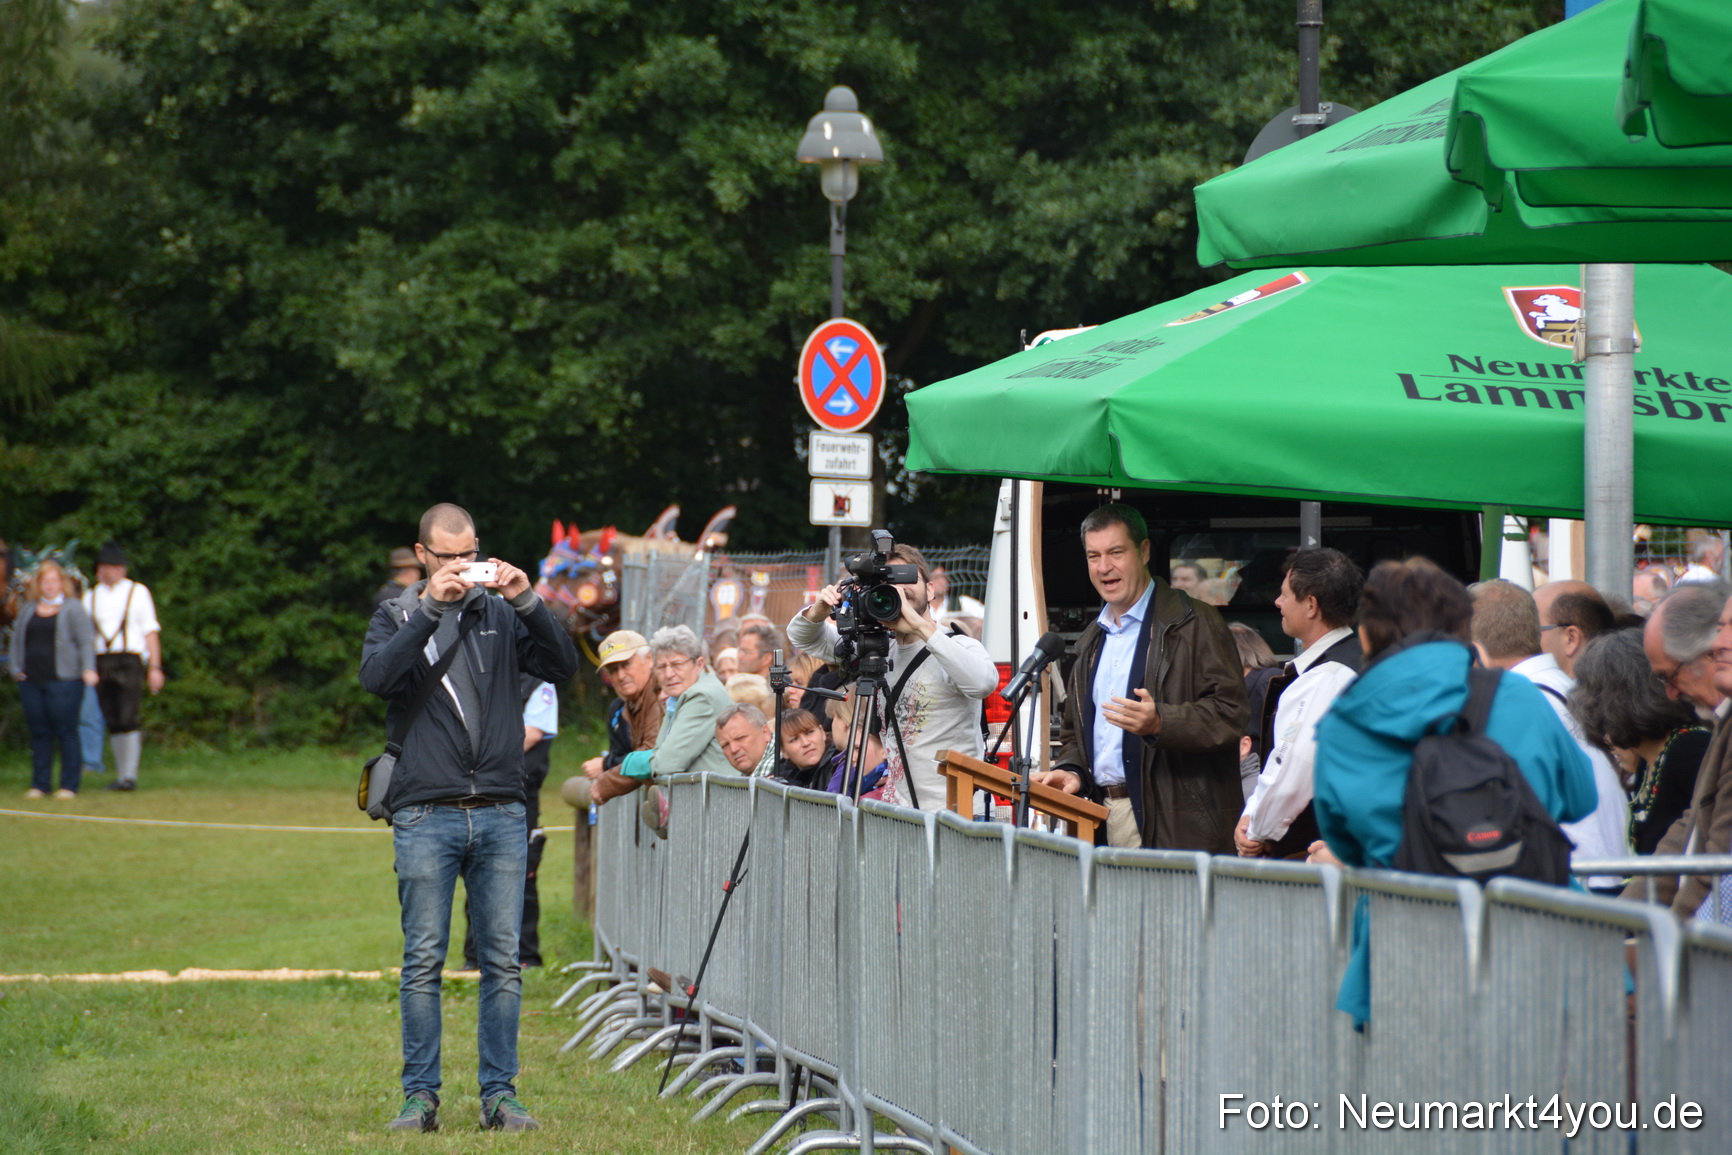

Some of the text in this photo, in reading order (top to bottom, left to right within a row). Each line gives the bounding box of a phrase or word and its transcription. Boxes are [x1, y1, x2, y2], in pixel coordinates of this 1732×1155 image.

[815, 439, 866, 454] Feuerwehr-
[825, 456, 857, 470] zufahrt
[1467, 830, 1500, 842] Canon
